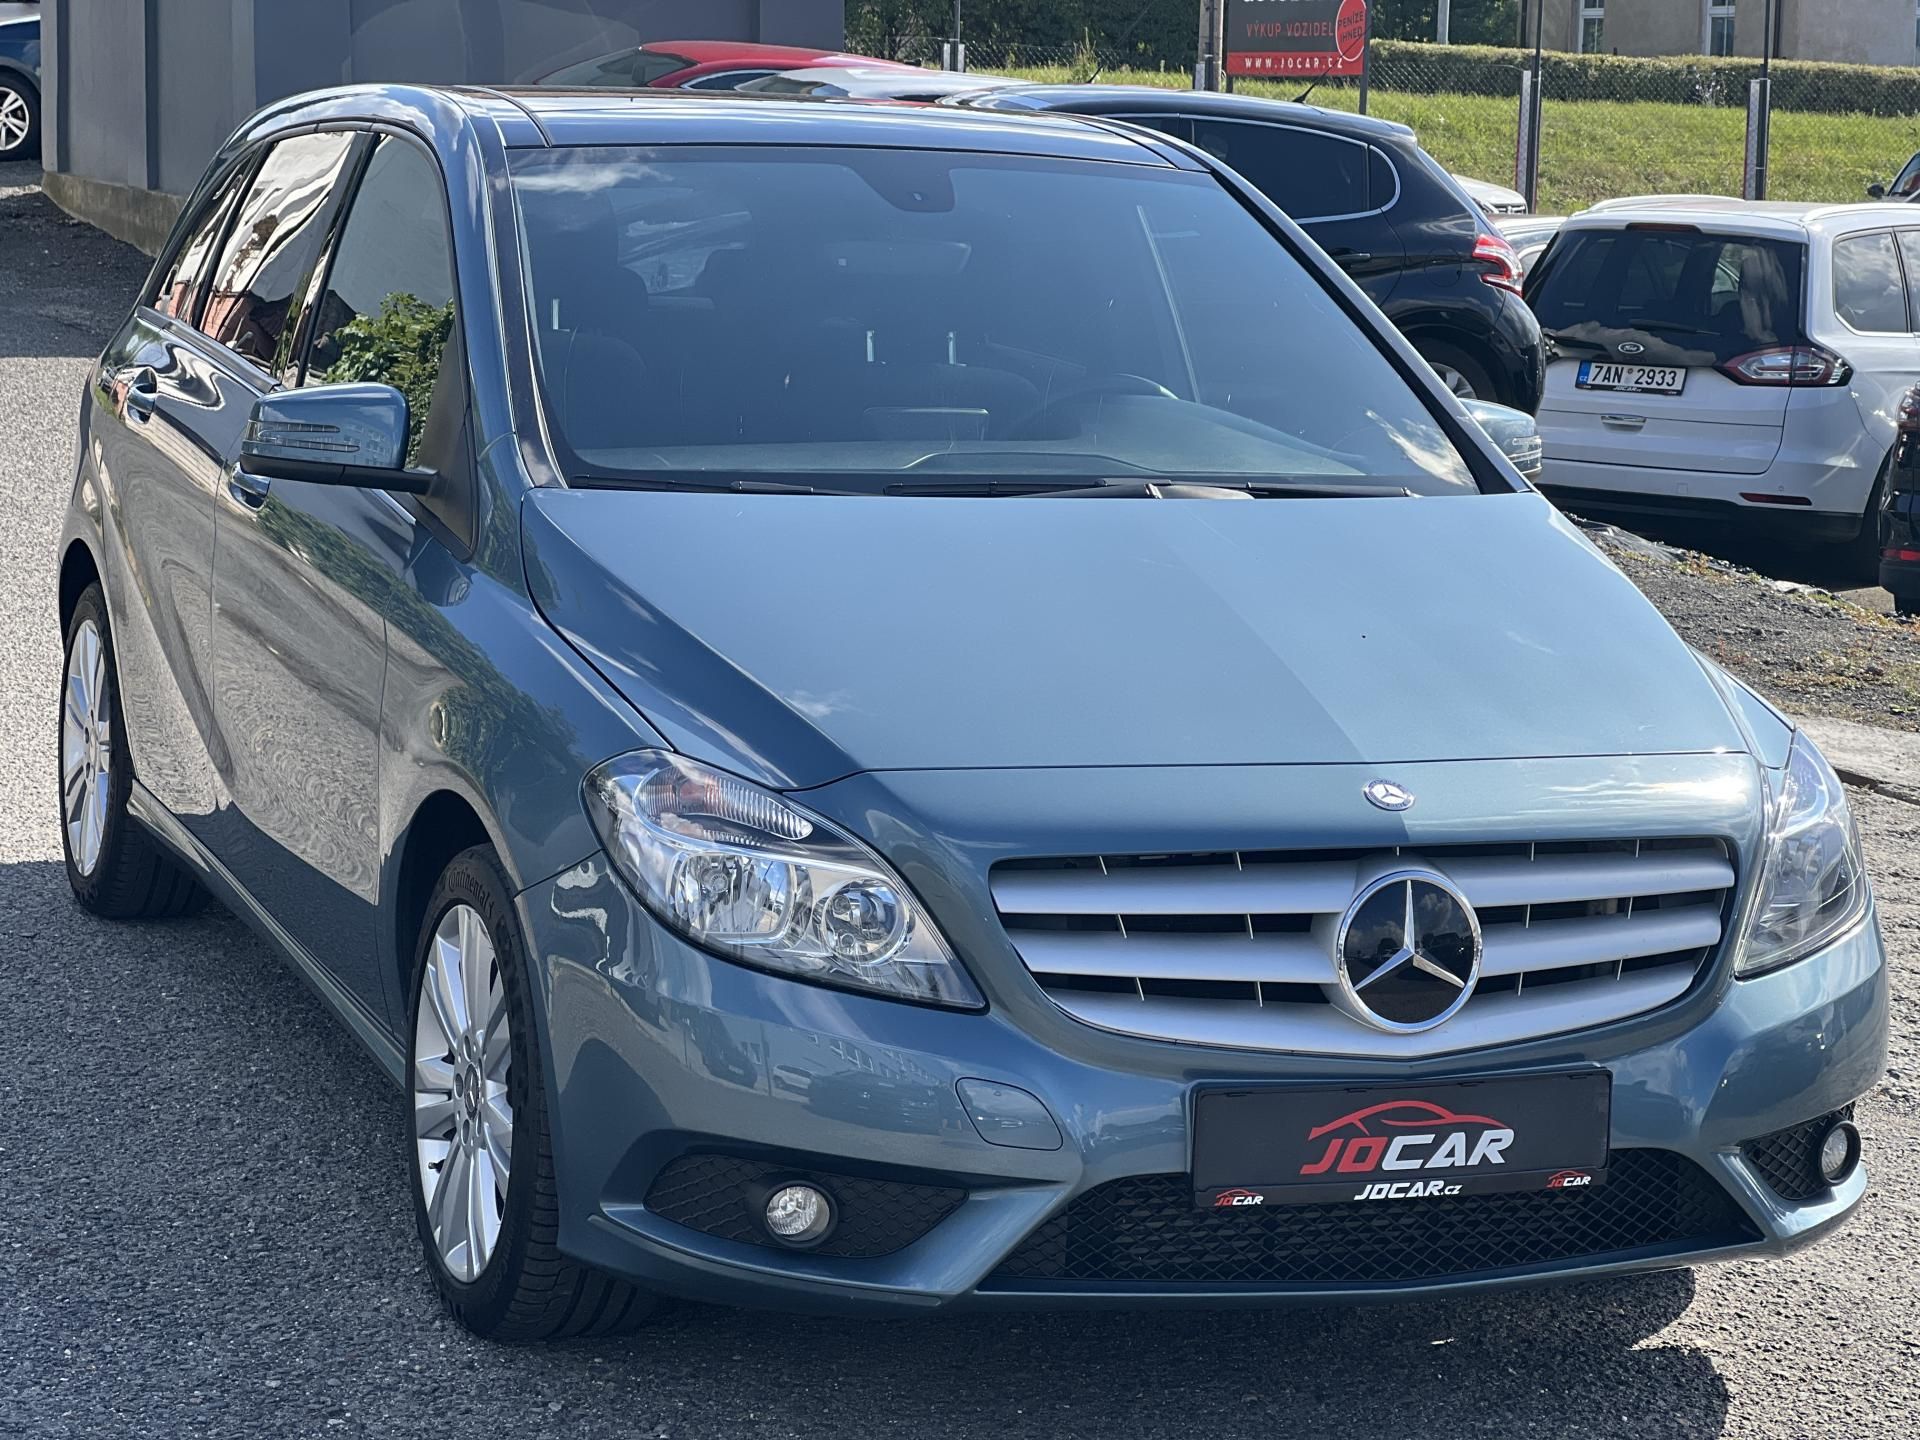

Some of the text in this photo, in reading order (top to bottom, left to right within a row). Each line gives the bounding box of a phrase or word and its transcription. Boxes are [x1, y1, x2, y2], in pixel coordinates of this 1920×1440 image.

[1338, 11, 1364, 27] PENÍZE
[1246, 20, 1334, 38] VÝKUP VOZIDEL
[1341, 26, 1363, 43] IHNED
[1245, 57, 1343, 69] WWW.JOCAR.CZ
[1592, 365, 1625, 384] 7AN
[1634, 368, 1677, 387] 2933
[1299, 1128, 1515, 1174] JOCAR
[1546, 1175, 1592, 1188] JOCAR
[1214, 1193, 1264, 1206] JOCAR
